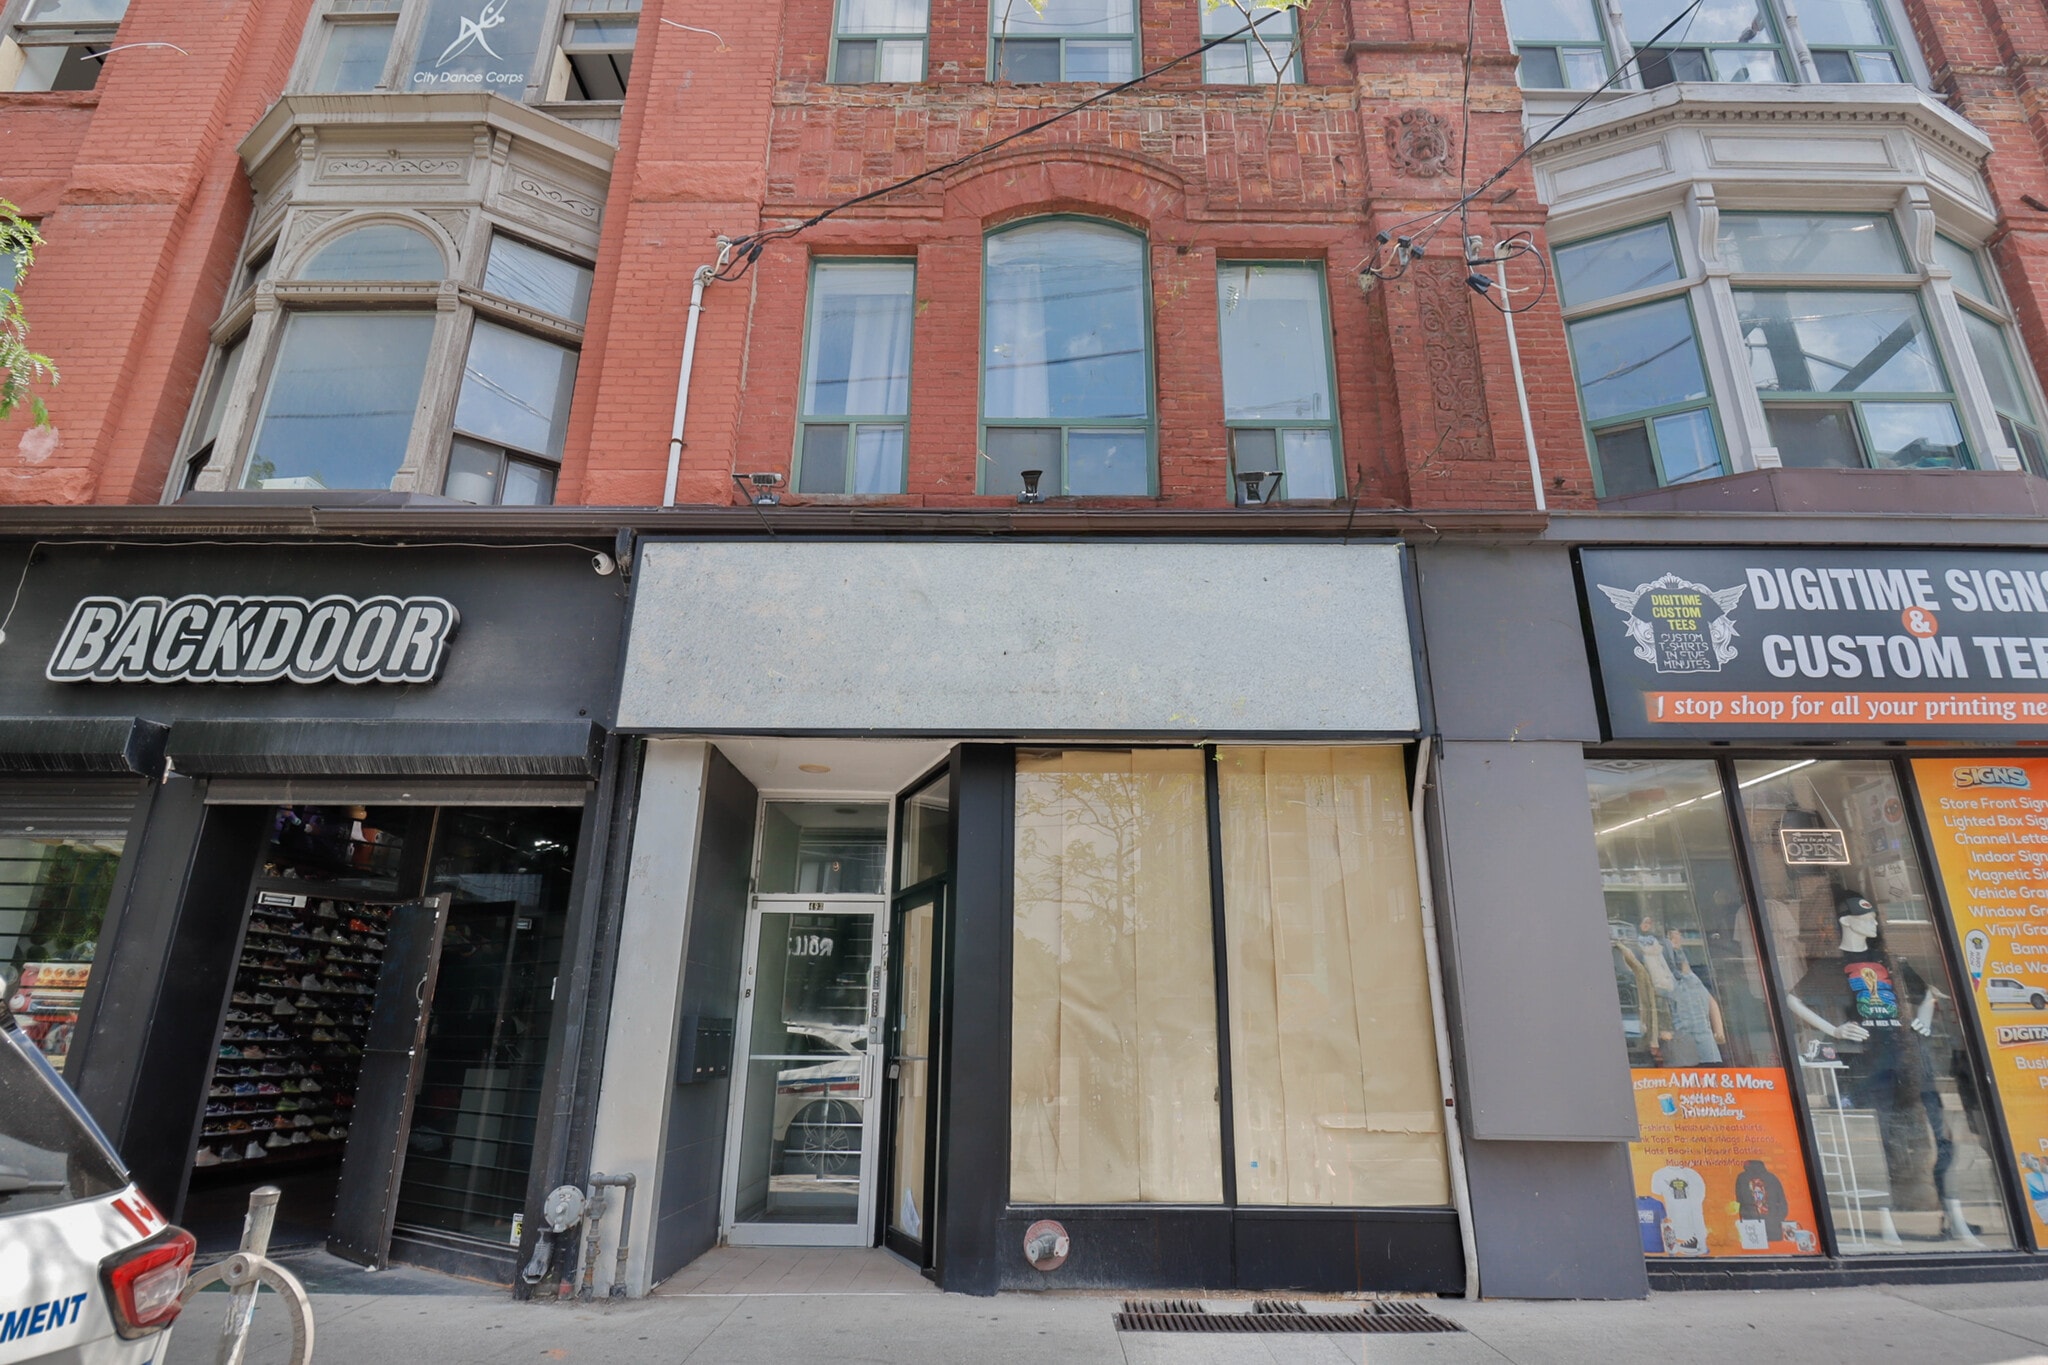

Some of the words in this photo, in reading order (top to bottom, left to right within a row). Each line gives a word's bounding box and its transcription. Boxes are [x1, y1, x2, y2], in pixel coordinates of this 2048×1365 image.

[413, 72, 438, 85] City
[441, 72, 483, 83] Dance
[486, 71, 525, 84] Corps
[1746, 568, 1941, 611] DIGITIME
[1945, 569, 2048, 613] SIGN
[1650, 594, 1702, 606] DIGITIME
[1652, 606, 1702, 618] CUSTOM
[1667, 619, 1697, 631] TEES
[1908, 609, 1933, 635] &
[49, 598, 453, 680] BACKDOOR
[1661, 633, 1703, 642] CUSTOM
[1658, 642, 1709, 651] T-SHIRTS
[1762, 634, 1969, 679] CUSTOM
[1663, 659, 1711, 669] MINUTES
[1674, 697, 1723, 719] stop
[1730, 695, 1784, 720] shop
[1790, 695, 1824, 720] for
[1831, 696, 1860, 716] all
[1866, 700, 1918, 721] your
[1925, 696, 2017, 721] printing
[1954, 766, 2030, 788] SIGNS
[1939, 797, 1979, 809] Store
[1980, 797, 2019, 809] Front
[1943, 815, 1996, 830] Lighted
[1997, 815, 2024, 826] Box
[1954, 833, 2010, 845] Channel
[1787, 842, 1843, 857] OPEN
[1971, 850, 2016, 863] Indoor
[1968, 869, 2031, 884] Magnetic
[1967, 887, 2017, 899] Vehicle
[1967, 905, 2026, 917] Window
[2029, 904, 2048, 917] Gr
[1985, 923, 2020, 938] Vinyl
[1991, 961, 2023, 974] Side
[1869, 1006, 1889, 1015] FIFA
[1720, 1073, 1735, 1088] &
[1736, 1073, 1775, 1090] More
[1724, 1092, 1737, 1105] &
